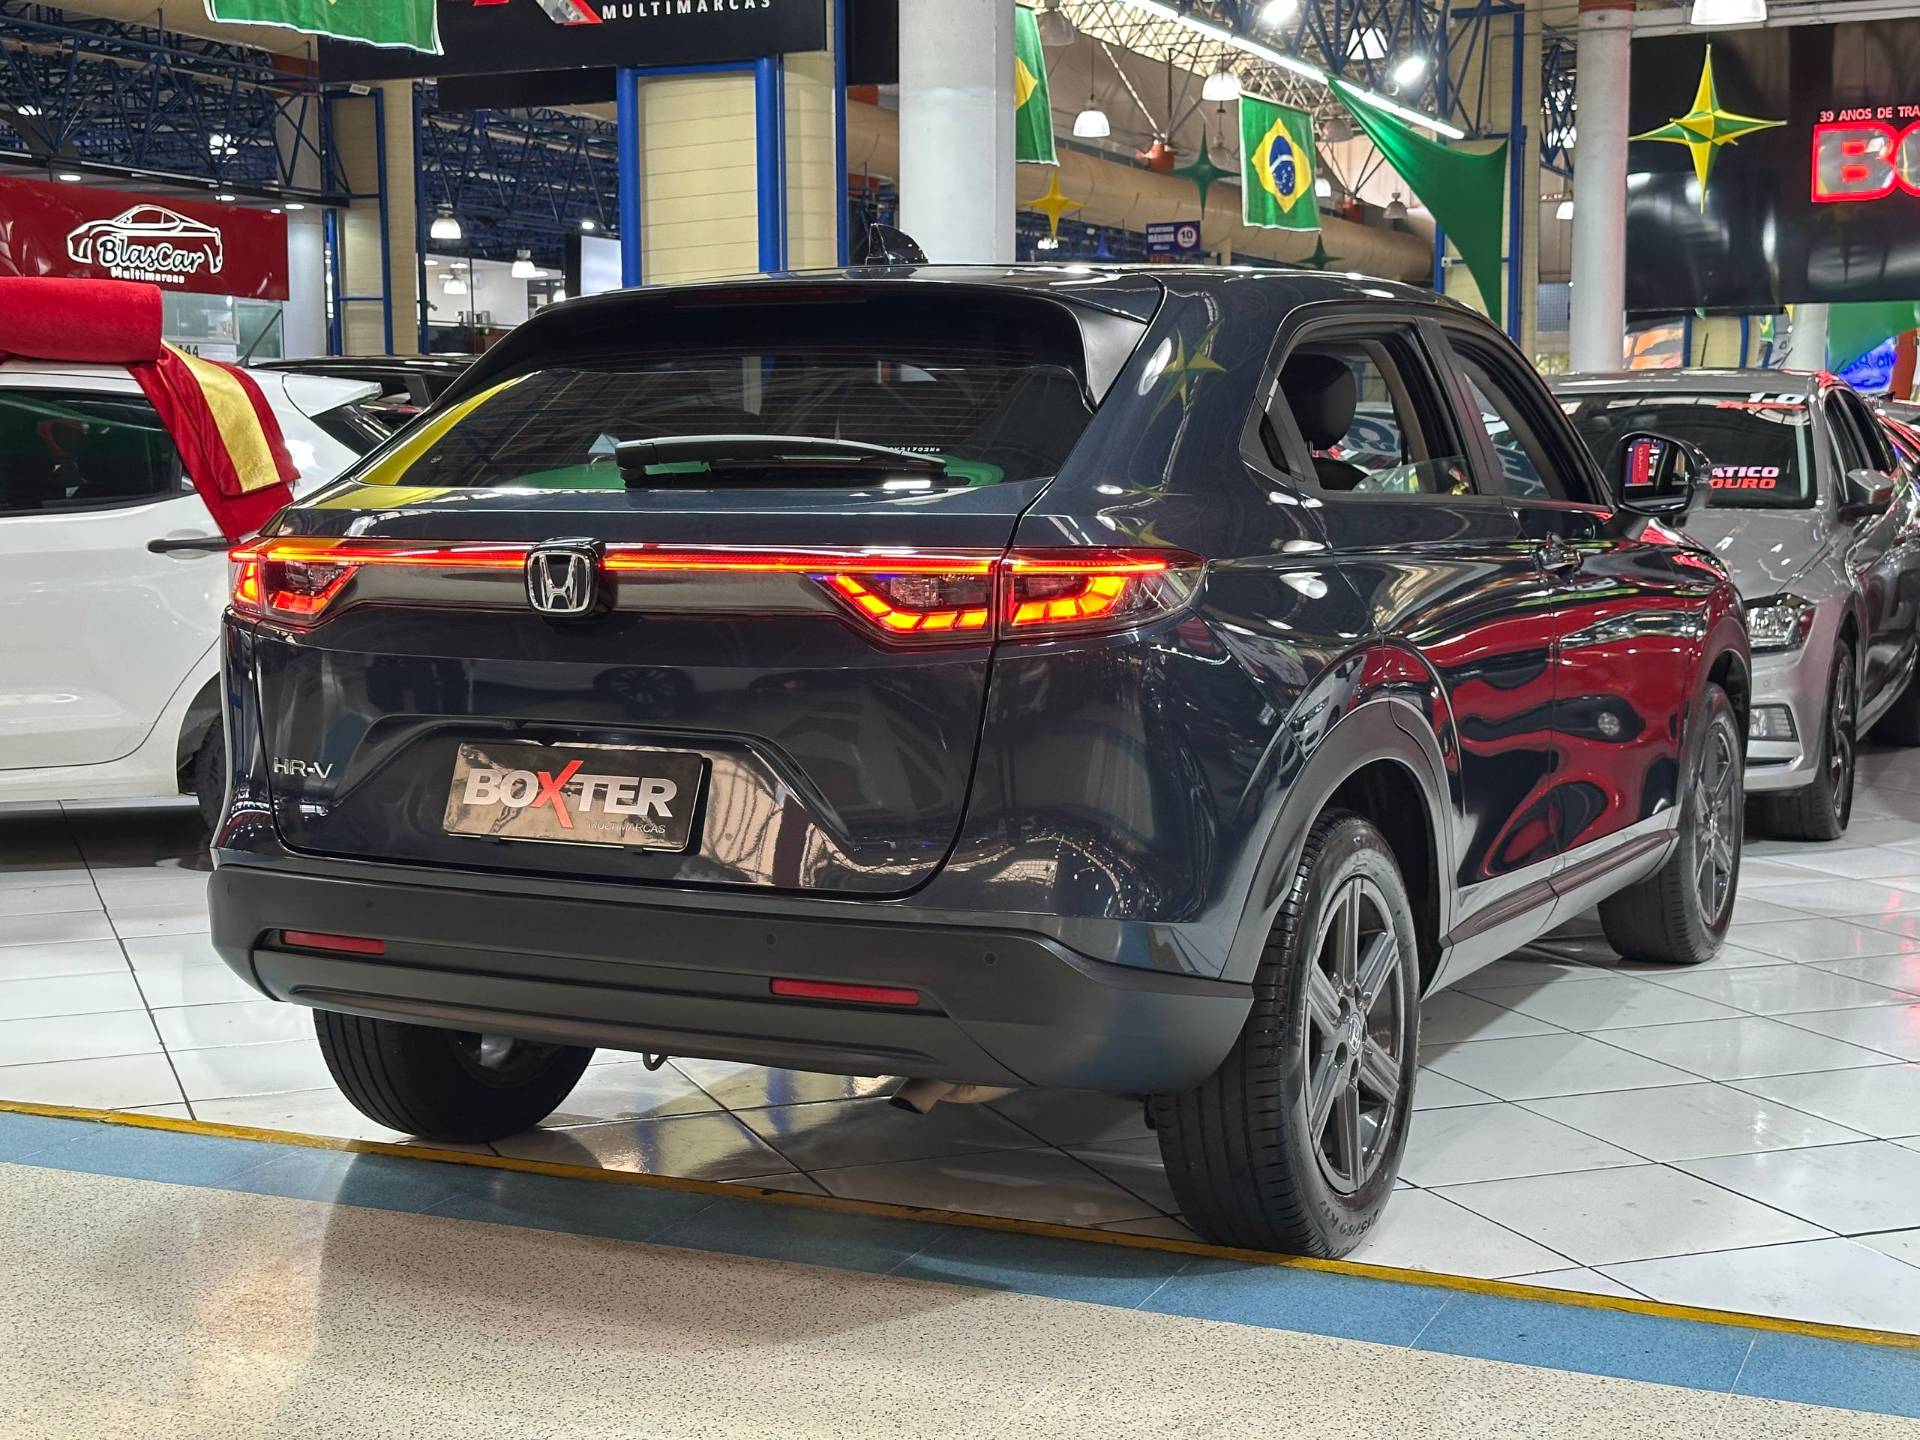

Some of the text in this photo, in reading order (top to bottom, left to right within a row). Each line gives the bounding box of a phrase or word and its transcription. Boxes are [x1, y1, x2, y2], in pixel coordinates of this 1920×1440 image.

[602, 0, 772, 20] MULTIMARCAS
[1820, 111, 1834, 122] 39
[1839, 108, 1872, 121] ANOS
[1877, 107, 1893, 119] DE
[1181, 230, 1193, 240] 10
[97, 234, 205, 274] BlasCar
[111, 266, 185, 285] Multimarcas
[273, 757, 334, 779] HR-V
[463, 760, 678, 829] BOXTER
[587, 820, 667, 835] MULTIMARCAS
